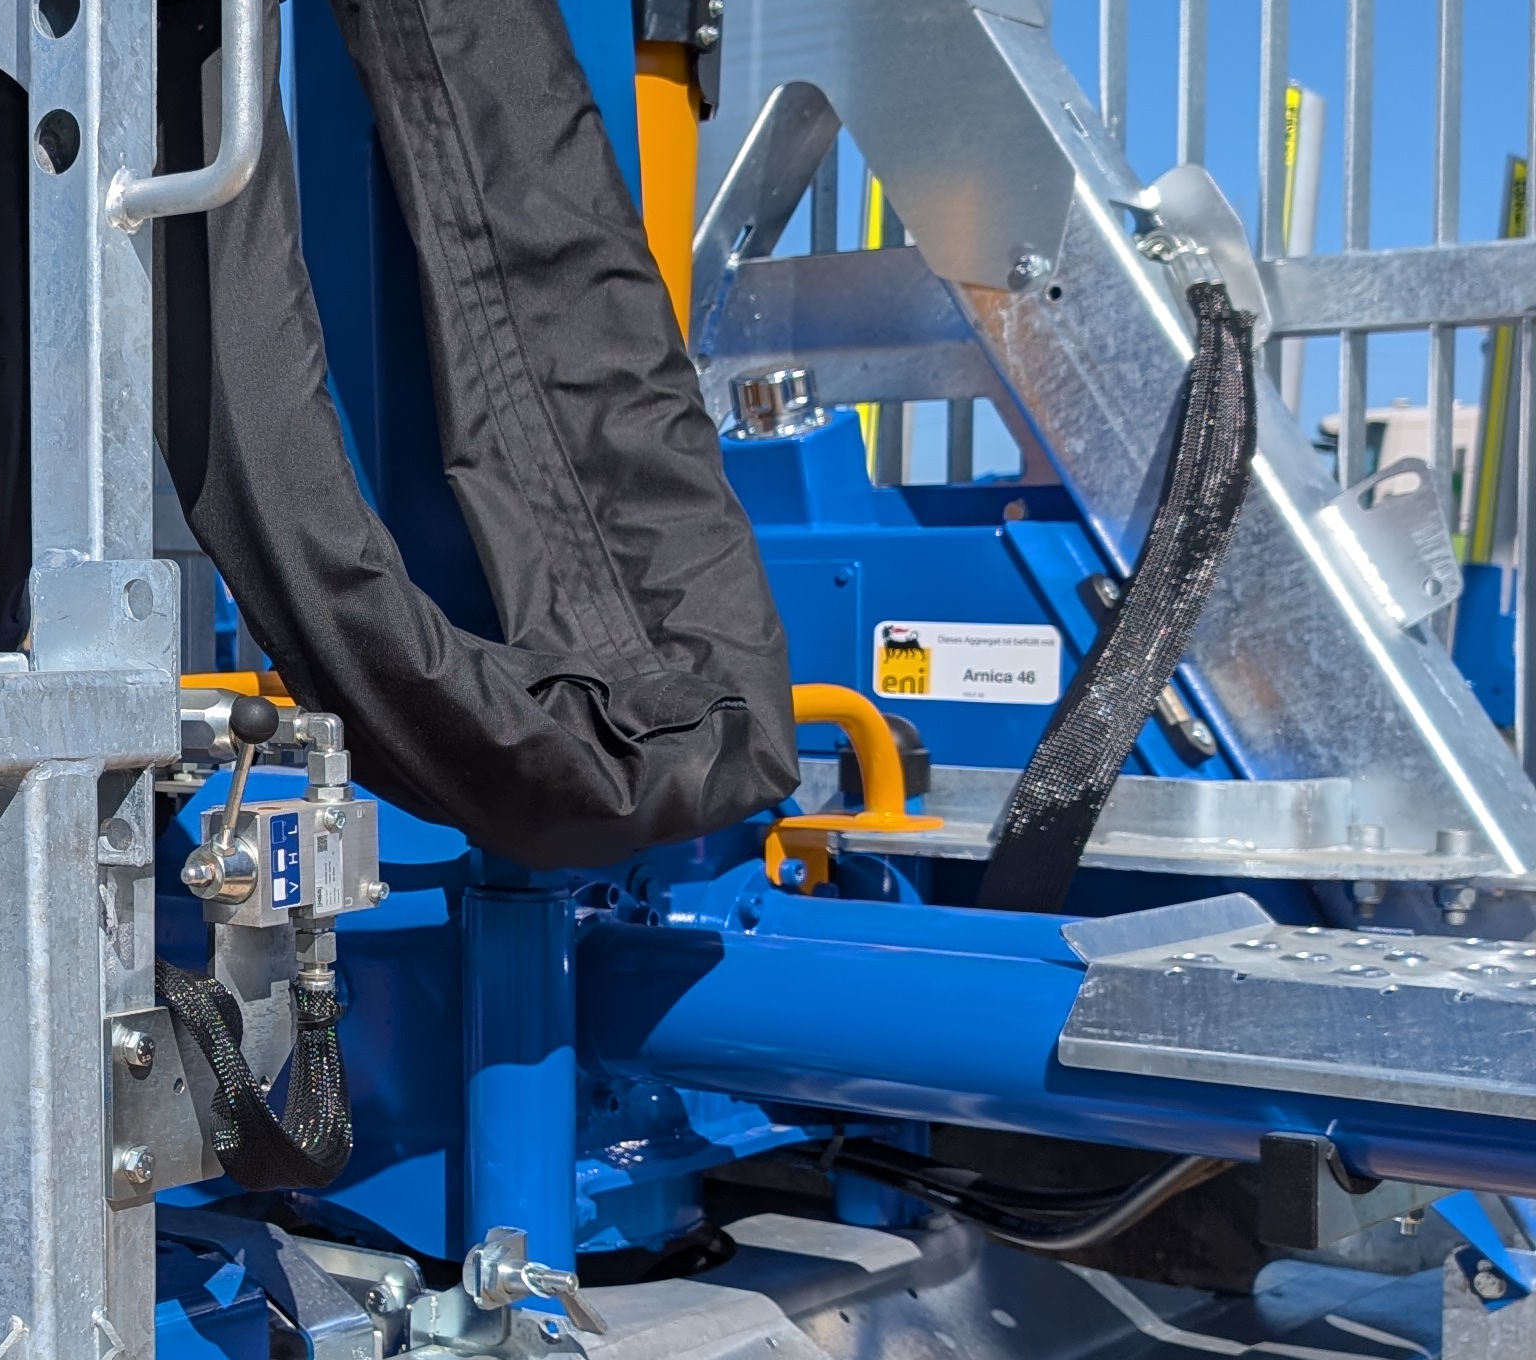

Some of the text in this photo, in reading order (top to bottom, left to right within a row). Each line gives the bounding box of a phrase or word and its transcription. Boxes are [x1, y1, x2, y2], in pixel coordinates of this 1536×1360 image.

[882, 668, 925, 694] eni
[963, 669, 1036, 684] Arnica 46
[288, 852, 298, 865] H
